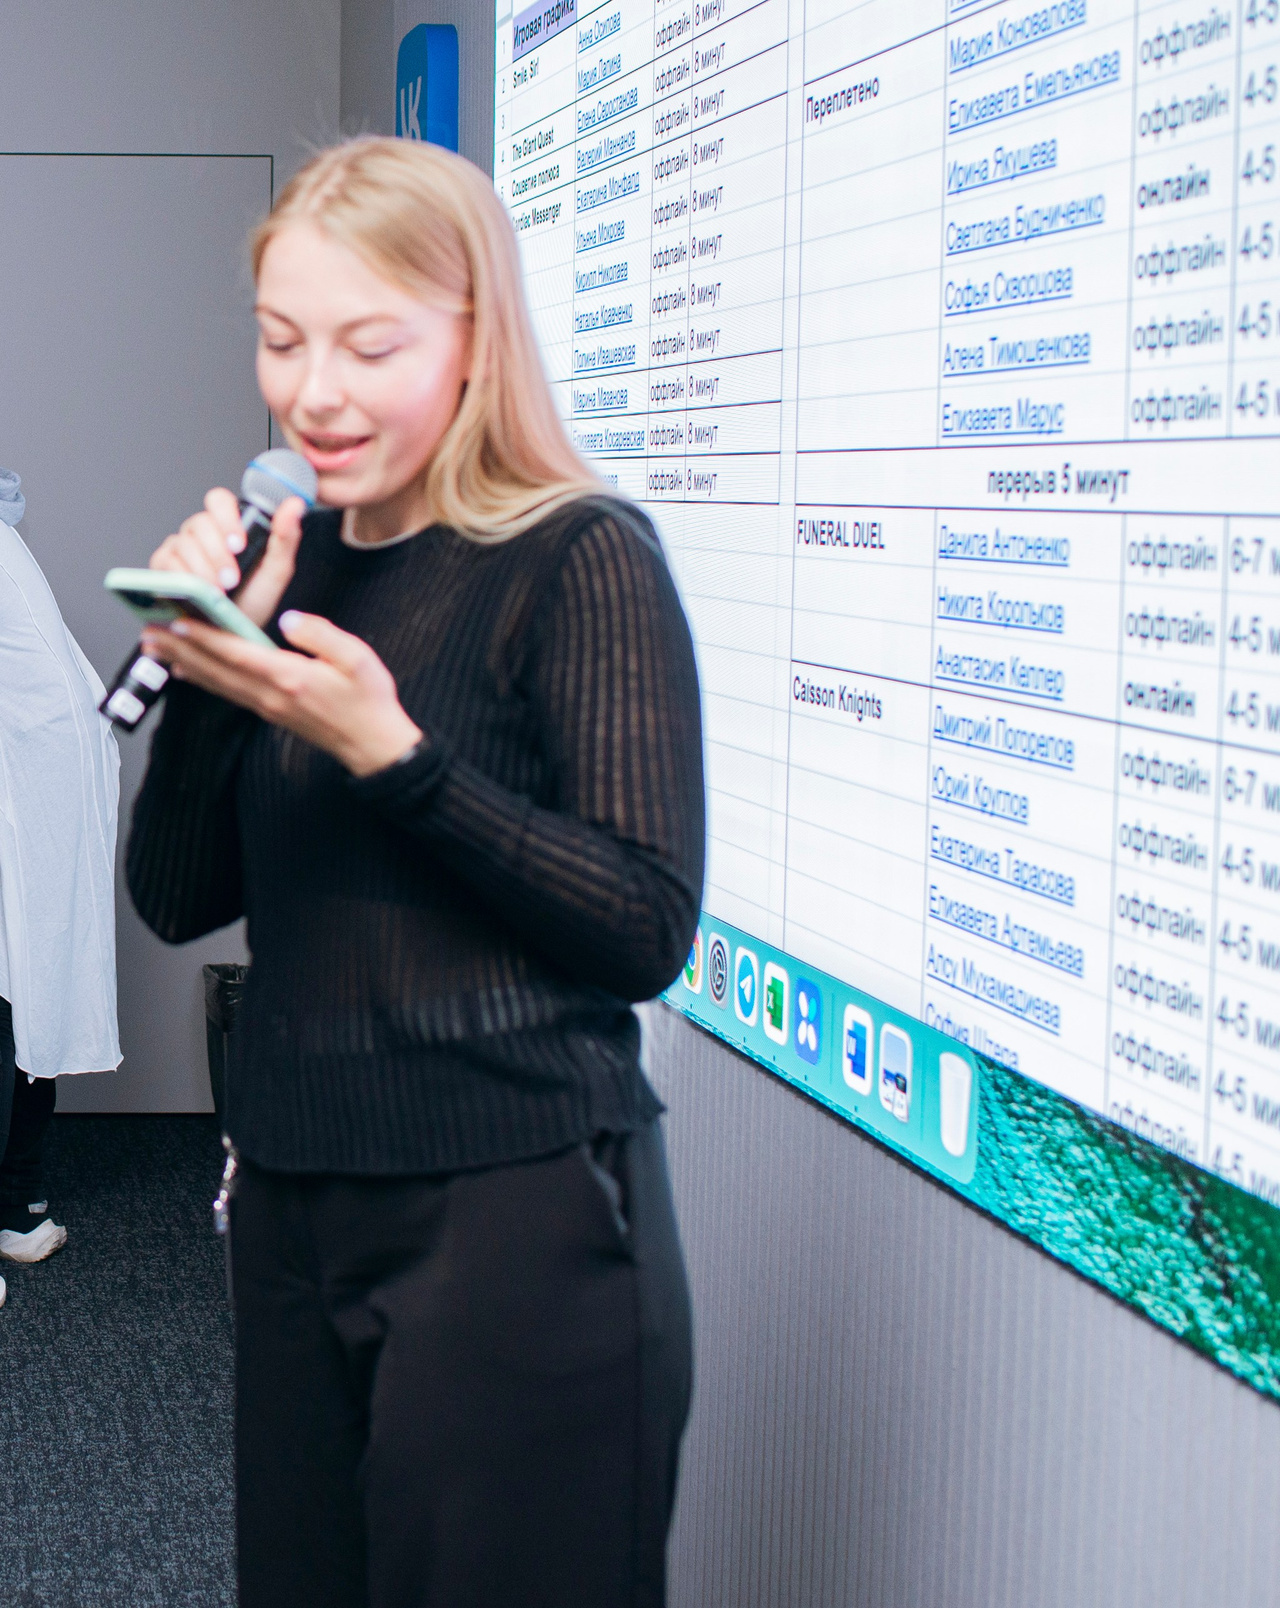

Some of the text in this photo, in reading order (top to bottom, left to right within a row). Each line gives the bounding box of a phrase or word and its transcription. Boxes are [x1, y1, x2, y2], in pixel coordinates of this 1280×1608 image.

[513, 0, 574, 51] Игровая графика
[578, 12, 620, 50] Анна Осипова
[655, 12, 690, 50] оффлайн
[694, 3, 700, 27] 8
[950, 1, 1085, 67] Мария Коновалова
[1141, 7, 1231, 70] оффлайн
[655, 58, 690, 95] оффлайн
[694, 42, 726, 74] 8 минут
[577, 66, 596, 89] Мария
[949, 49, 1118, 128] Елизавета Емельянова
[1244, 64, 1278, 108] 4-5
[578, 108, 595, 129] Елена
[693, 89, 725, 119] 8 минут
[805, 75, 880, 124] Переплетено
[1139, 83, 1229, 143] оффлайн
[654, 102, 689, 139] оффлайн
[512, 125, 554, 162] The Giant Quest
[577, 140, 602, 169] Валерий
[693, 137, 724, 166] 8 минут
[512, 164, 560, 198] Соцветие полюса
[654, 148, 689, 184] оффлайн
[947, 138, 1055, 189] Ирина Якушева
[1242, 144, 1276, 186] 4-5
[577, 184, 606, 209] Екатерина
[692, 186, 723, 212] 8 минут
[1138, 163, 1210, 209] онлайн
[532, 202, 561, 227] Messenger
[653, 194, 688, 229] оффлайн
[691, 234, 722, 260] 8 минут
[947, 216, 1008, 250] Светлана
[1240, 222, 1274, 262] 4-5
[575, 261, 627, 288] Кирилл Николаев
[652, 240, 687, 273] оффлайн
[1135, 233, 1226, 286] оффлайн
[652, 286, 687, 319] оффлайн
[690, 282, 721, 308] 8 минут
[945, 267, 1071, 313] Софья Скворцова
[575, 303, 631, 329] Наталья Кравченко
[1134, 309, 1224, 359] оффлайн
[1238, 300, 1272, 340] 4-5
[574, 349, 595, 368] Полина
[651, 331, 686, 363] оффлайн
[689, 328, 720, 354] 8 минут
[943, 332, 1088, 370] Алена Тимошенкова
[573, 390, 595, 408] Марина
[650, 377, 685, 407] оффлайн
[688, 375, 719, 402] 8 минут
[1131, 384, 1222, 431] оффлайн
[1236, 379, 1269, 418] 4-5
[942, 398, 1063, 432] Елизавета Марус
[573, 430, 602, 449] Елизавета
[650, 423, 684, 452] оффлайн
[688, 422, 718, 449] 8 минут
[649, 469, 683, 497] оффлайн
[687, 469, 717, 497] 8 минут
[987, 462, 1131, 503] перерыв 5 минут
[797, 519, 886, 550] FUNERAL DUEL
[939, 525, 1067, 560] Данила Антоненко
[1127, 533, 1218, 577] оффлайн
[1231, 537, 1265, 575] 6-7
[937, 585, 981, 617] Никита
[1125, 606, 1216, 651] оффлайн
[1229, 615, 1263, 652] 4-5
[935, 644, 1004, 683] Анастасия
[793, 675, 883, 722] Caisson Knights
[1124, 679, 1196, 718] онлайн
[1227, 690, 1260, 729] 4-5
[934, 704, 990, 745] Дмитрий
[932, 764, 969, 803] Юрий
[1121, 748, 1211, 795] оффлайн
[1223, 765, 1257, 807] 6-7
[932, 825, 1074, 900] Екатерина Тарасова
[1119, 819, 1209, 871] оффлайн
[1222, 843, 1255, 885] 4-5
[929, 884, 1083, 973] Елизавета Артемьева
[1117, 889, 1206, 945] оффлайн
[1220, 920, 1252, 961] 4-5
[926, 942, 956, 984] Алсу
[1114, 961, 1203, 1020] оффлайн
[1217, 994, 1250, 1039] 4-5
[1112, 1029, 1200, 1092] оффлайн
[1214, 1068, 1247, 1114] 4-5
